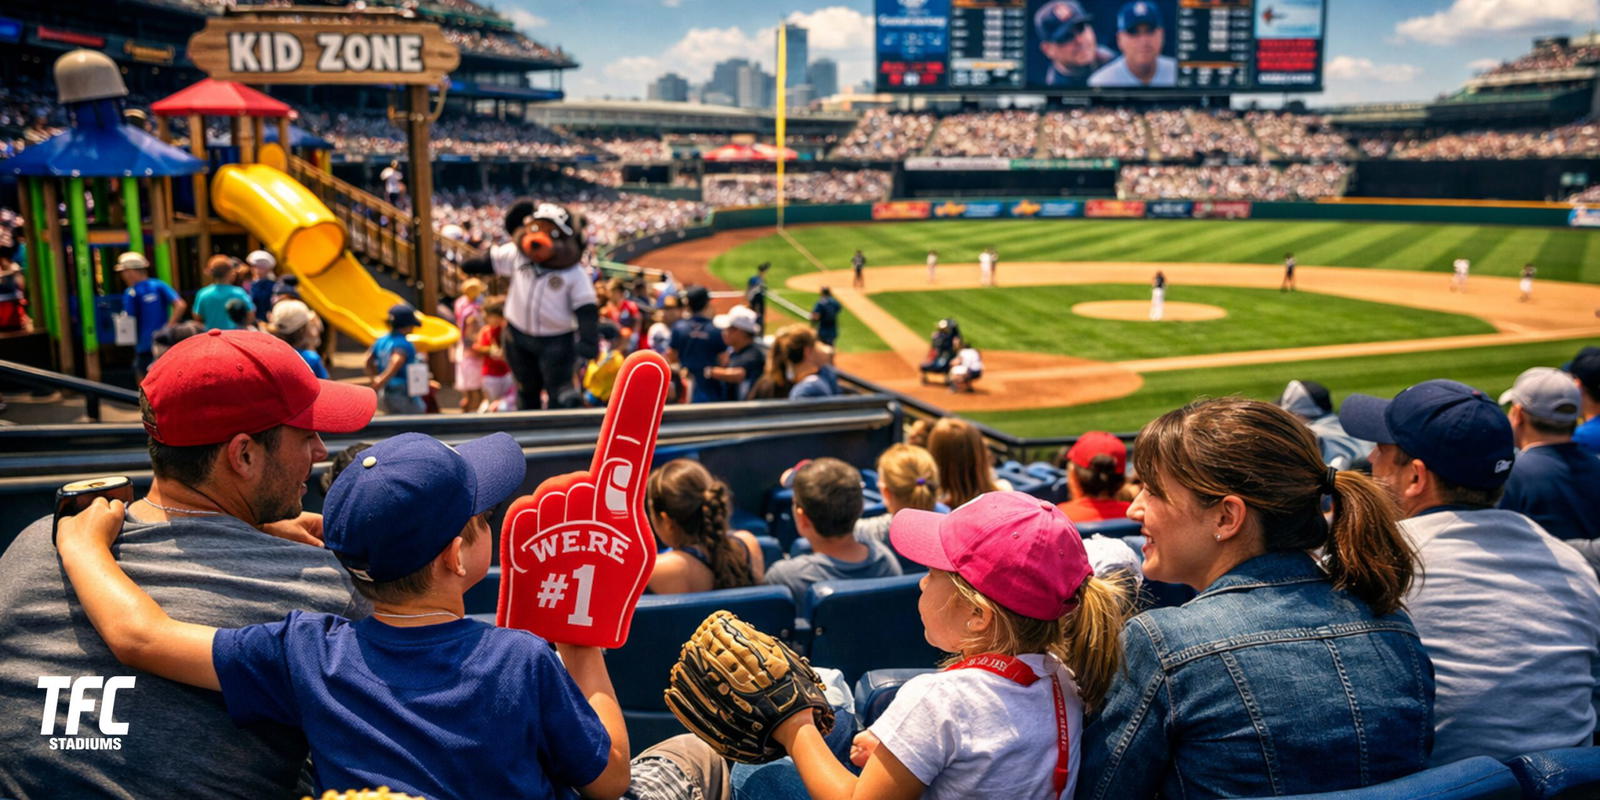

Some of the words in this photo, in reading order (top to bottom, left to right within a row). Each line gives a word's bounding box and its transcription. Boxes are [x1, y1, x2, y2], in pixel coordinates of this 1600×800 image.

[229, 32, 303, 72] KID
[316, 33, 424, 72] ZONE
[529, 530, 631, 564] WE.RE
[536, 564, 596, 627] #1
